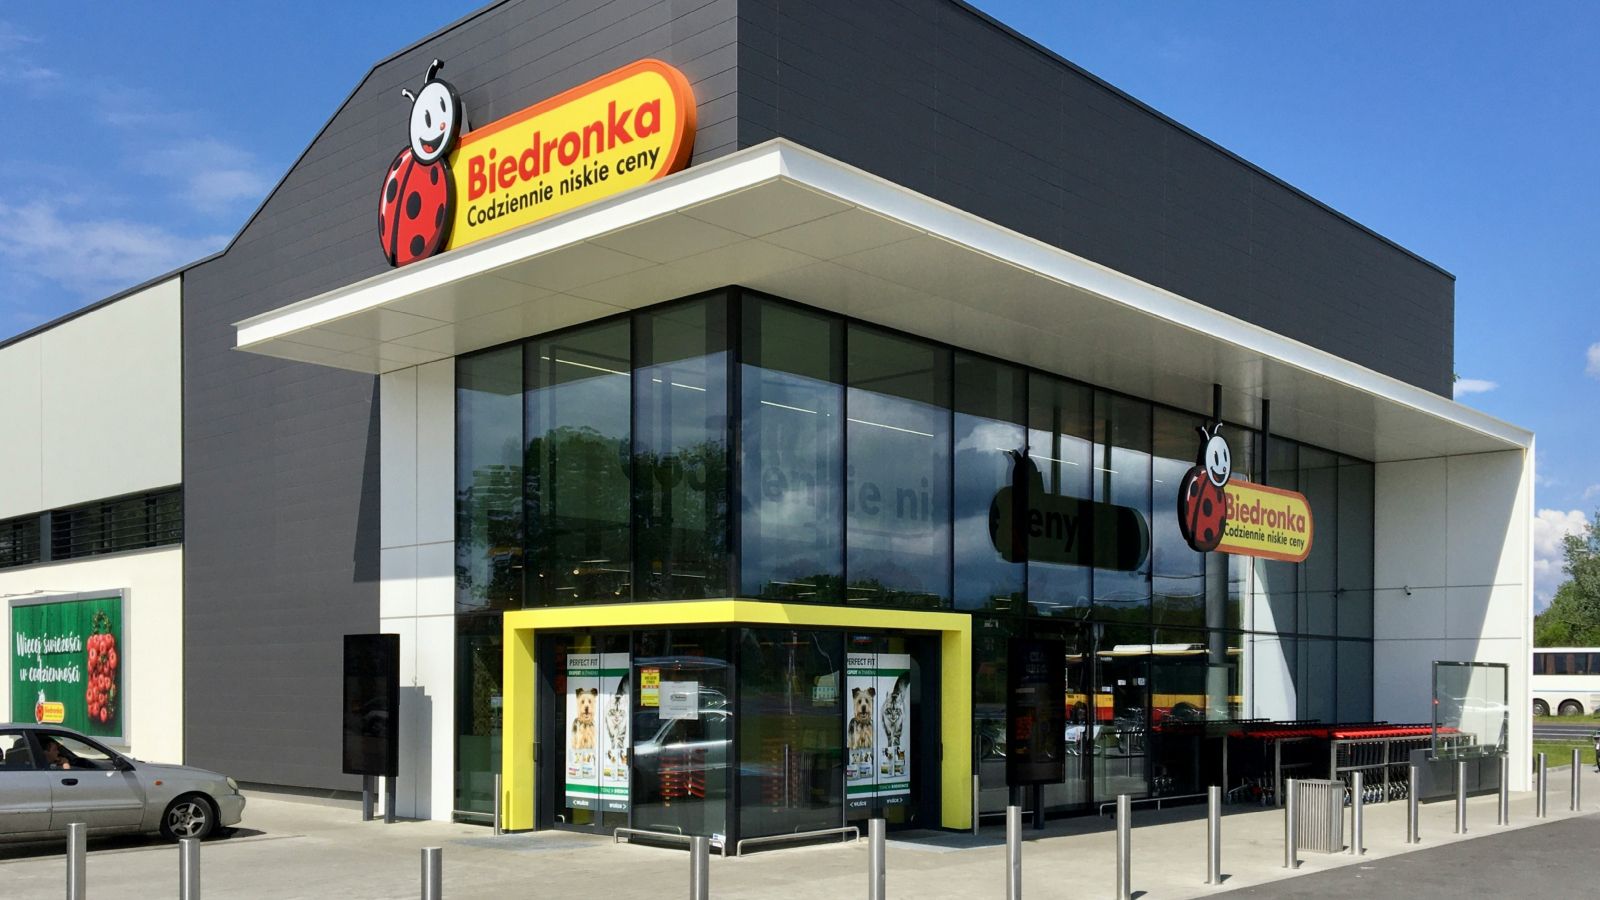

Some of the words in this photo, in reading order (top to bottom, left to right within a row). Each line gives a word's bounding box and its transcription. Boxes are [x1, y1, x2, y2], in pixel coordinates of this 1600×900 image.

[468, 98, 661, 202] Biedronka
[467, 179, 553, 227] Codziennie
[560, 161, 609, 196] niskie
[616, 146, 661, 175] ceny
[1226, 492, 1306, 534] Biedronka
[1224, 522, 1265, 542] Codziennie
[1267, 531, 1288, 545] niskie
[1289, 537, 1305, 550] ceny
[16, 631, 42, 661] Więcej
[43, 631, 82, 654] świeżości
[29, 659, 80, 683] codzienności
[569, 658, 590, 667] PERFECT
[590, 658, 598, 667] FIT
[867, 658, 875, 667] FIT
